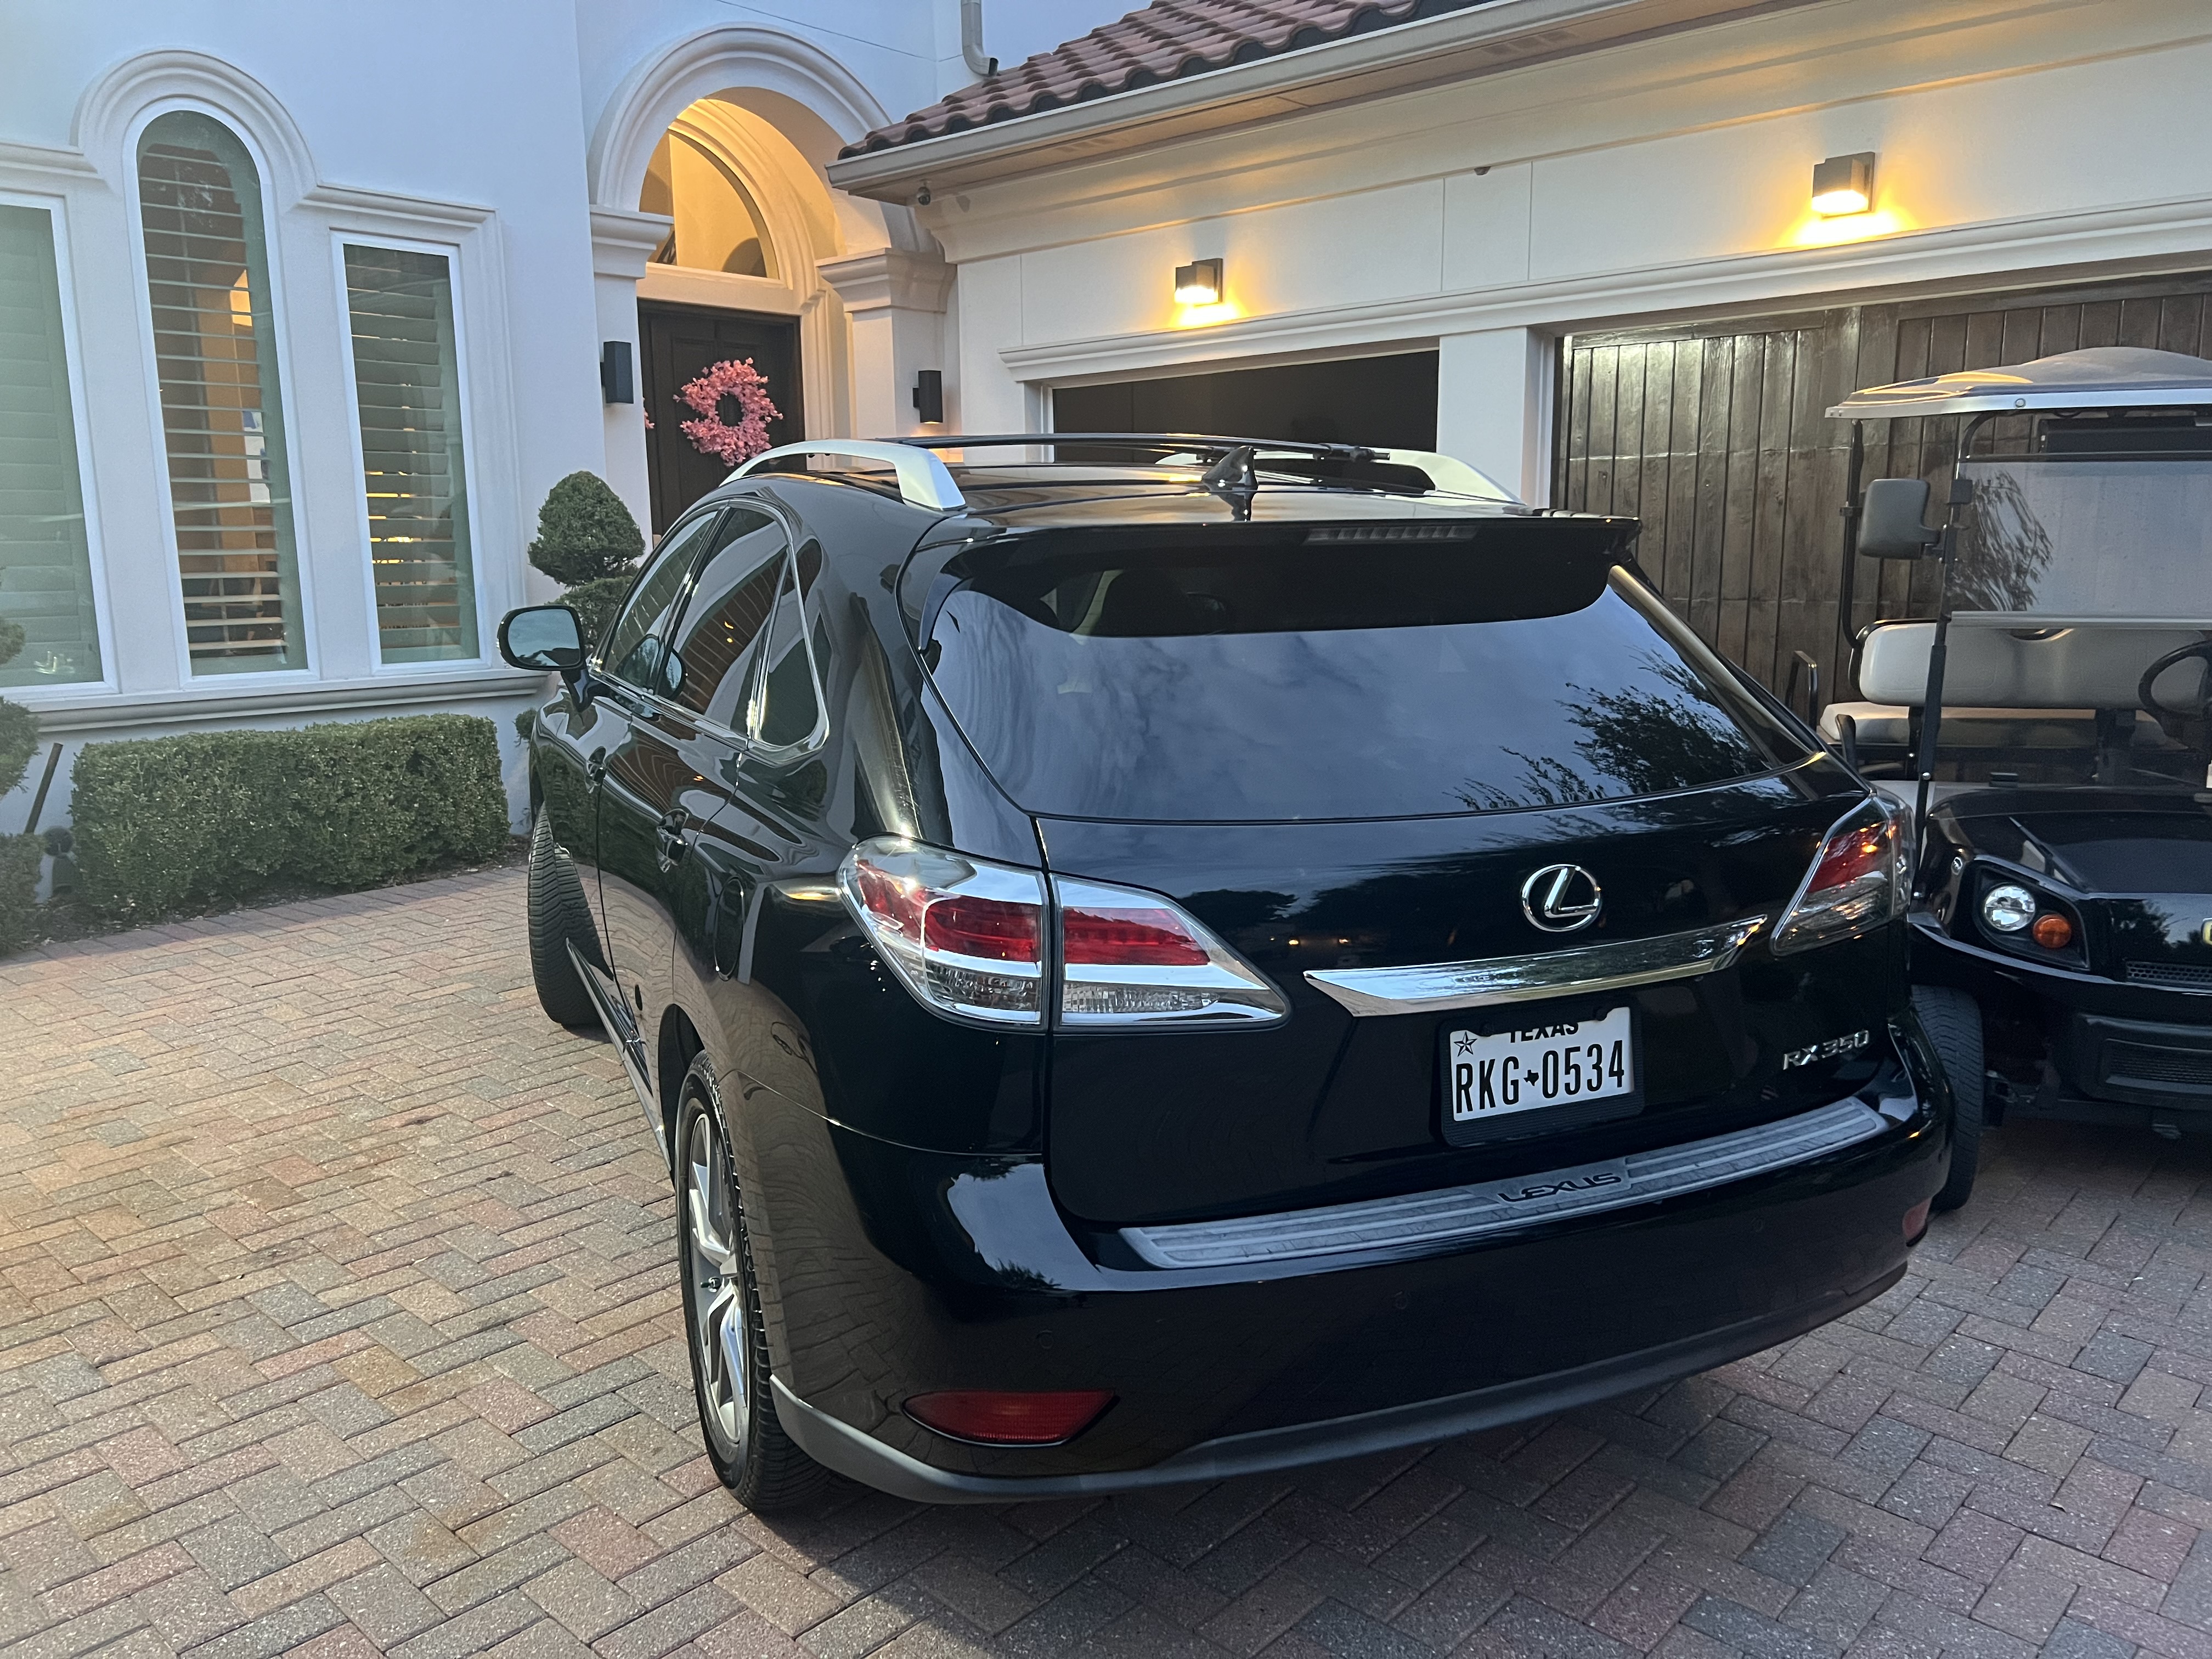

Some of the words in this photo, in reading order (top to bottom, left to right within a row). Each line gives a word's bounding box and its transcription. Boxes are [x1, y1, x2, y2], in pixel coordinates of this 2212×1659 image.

[1783, 1045, 1818, 1070] RX
[1821, 1030, 1869, 1059] 350
[1497, 1173, 1622, 1203] LEXUS
